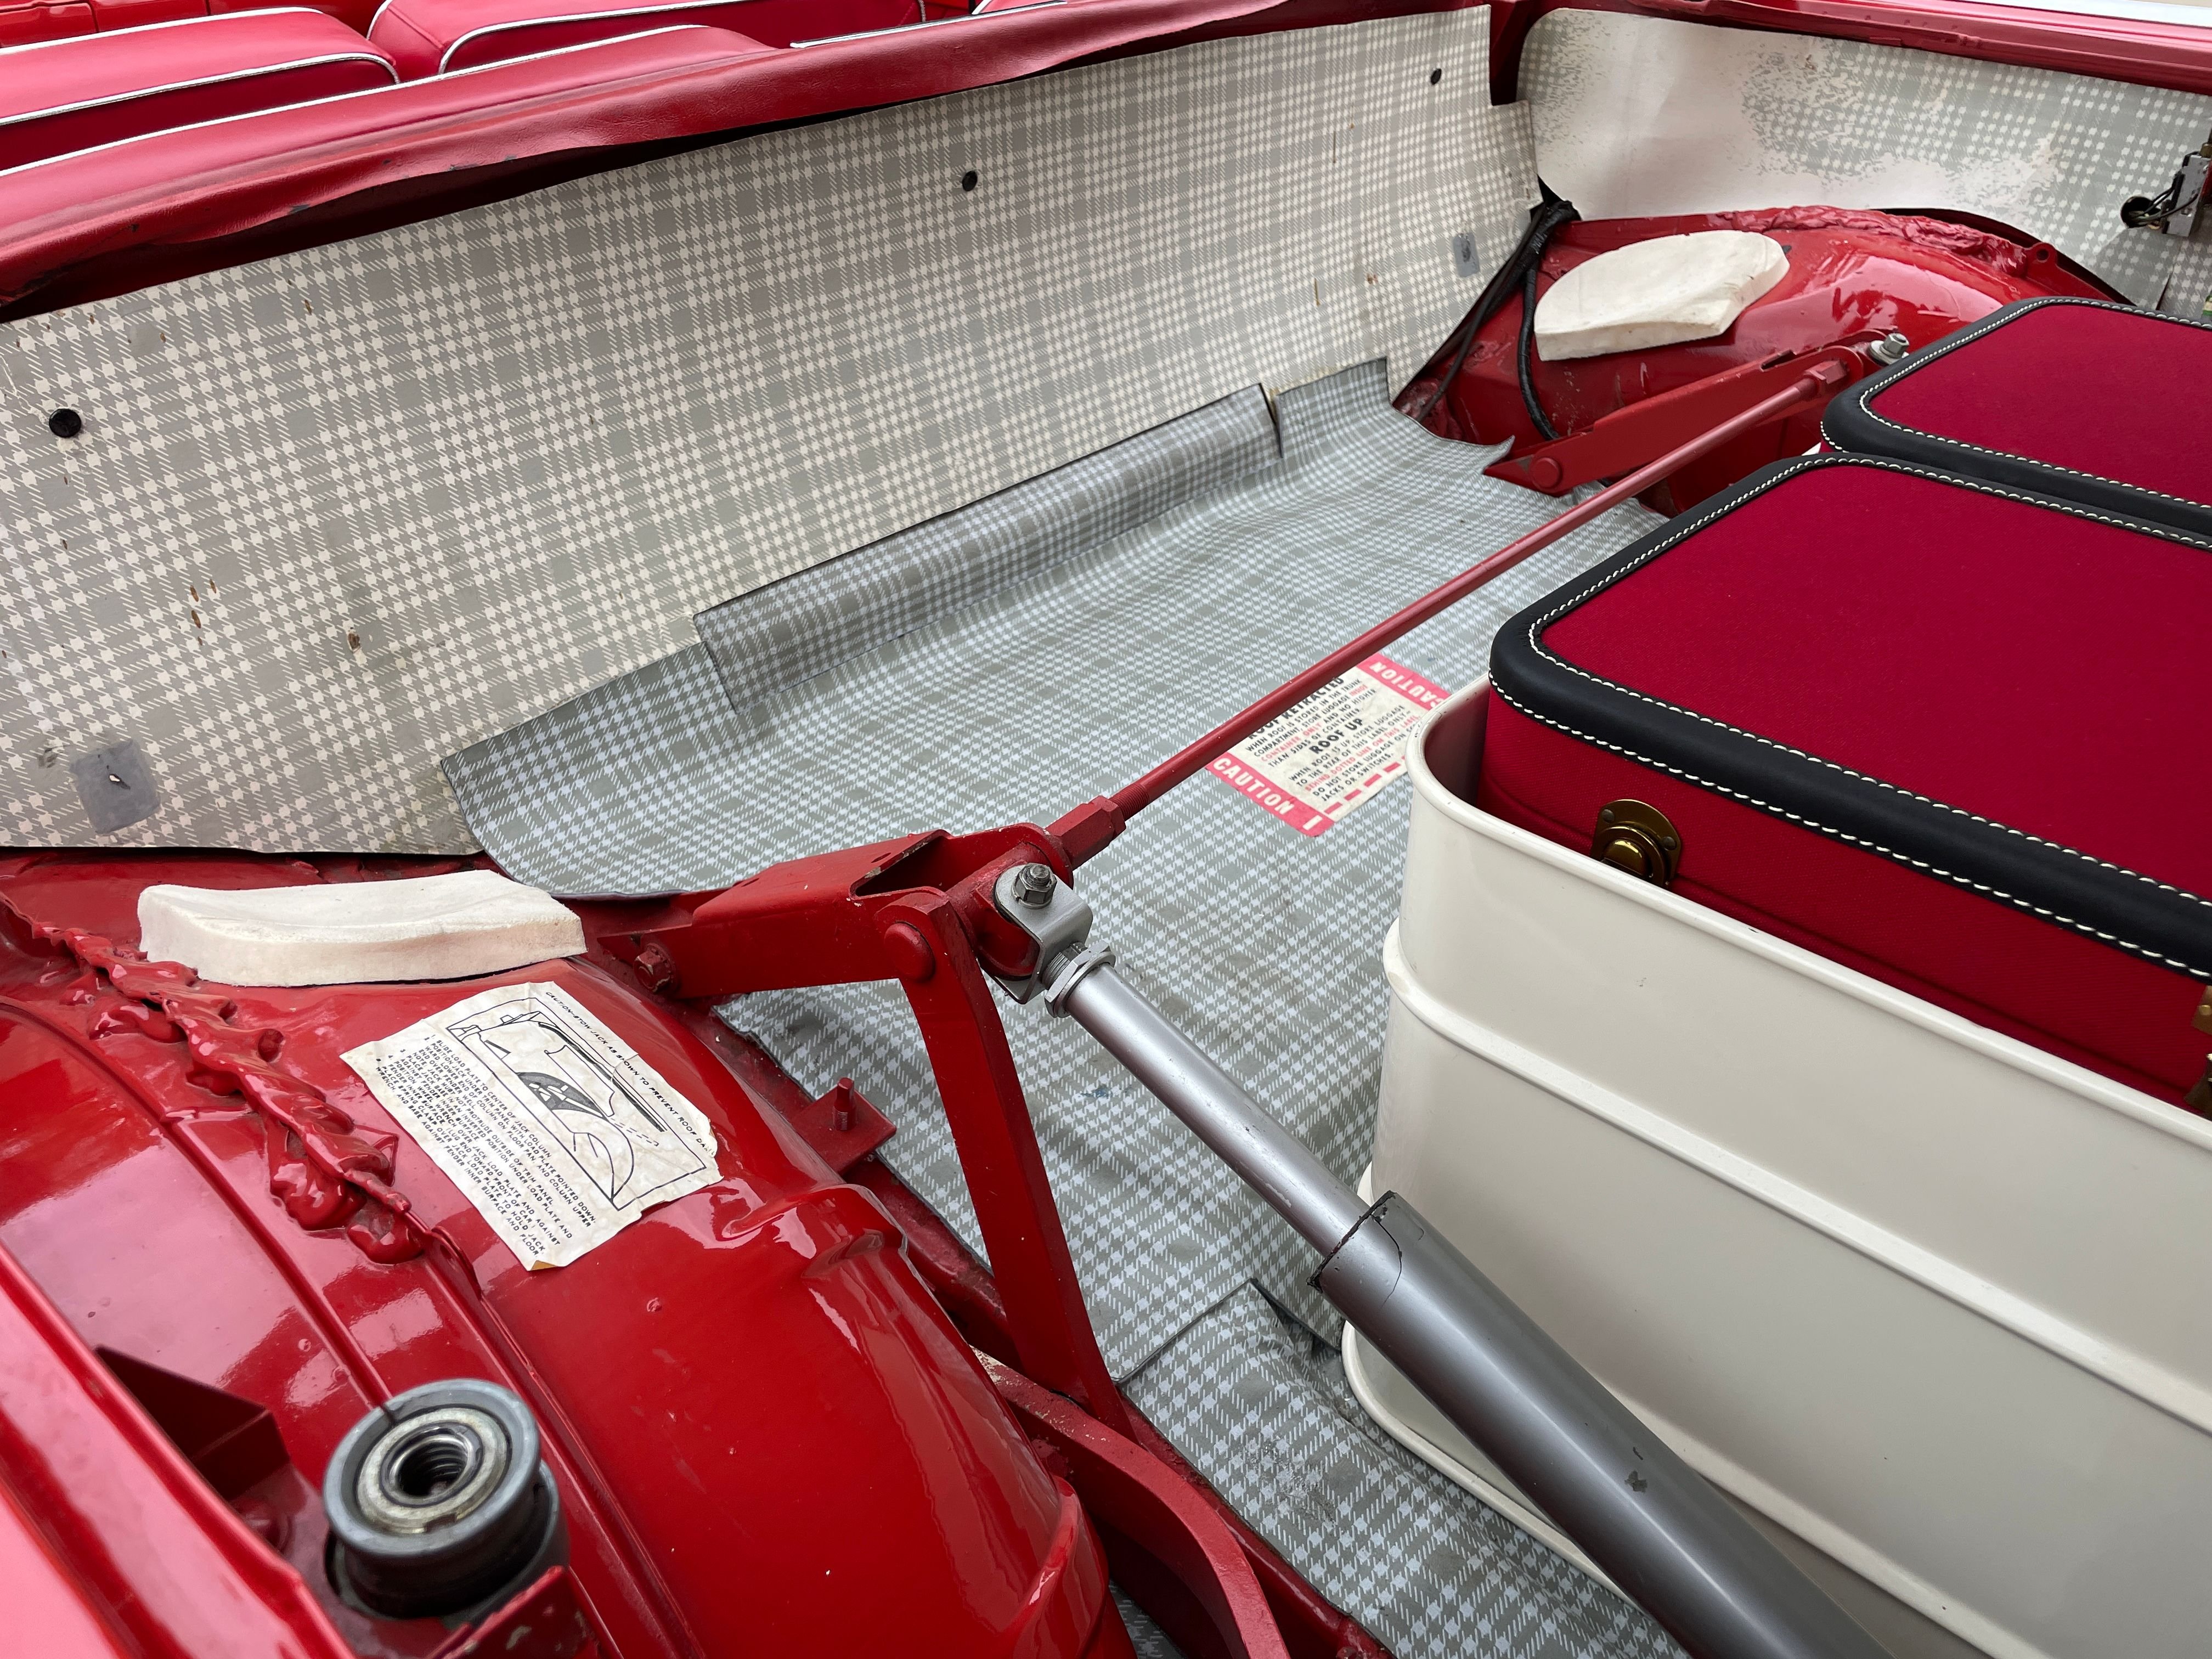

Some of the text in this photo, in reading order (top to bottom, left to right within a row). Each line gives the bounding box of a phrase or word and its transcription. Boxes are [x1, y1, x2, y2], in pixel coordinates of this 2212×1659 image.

[1309, 718, 1363, 754] ROOF UP
[1214, 758, 1294, 814] CAUTION
